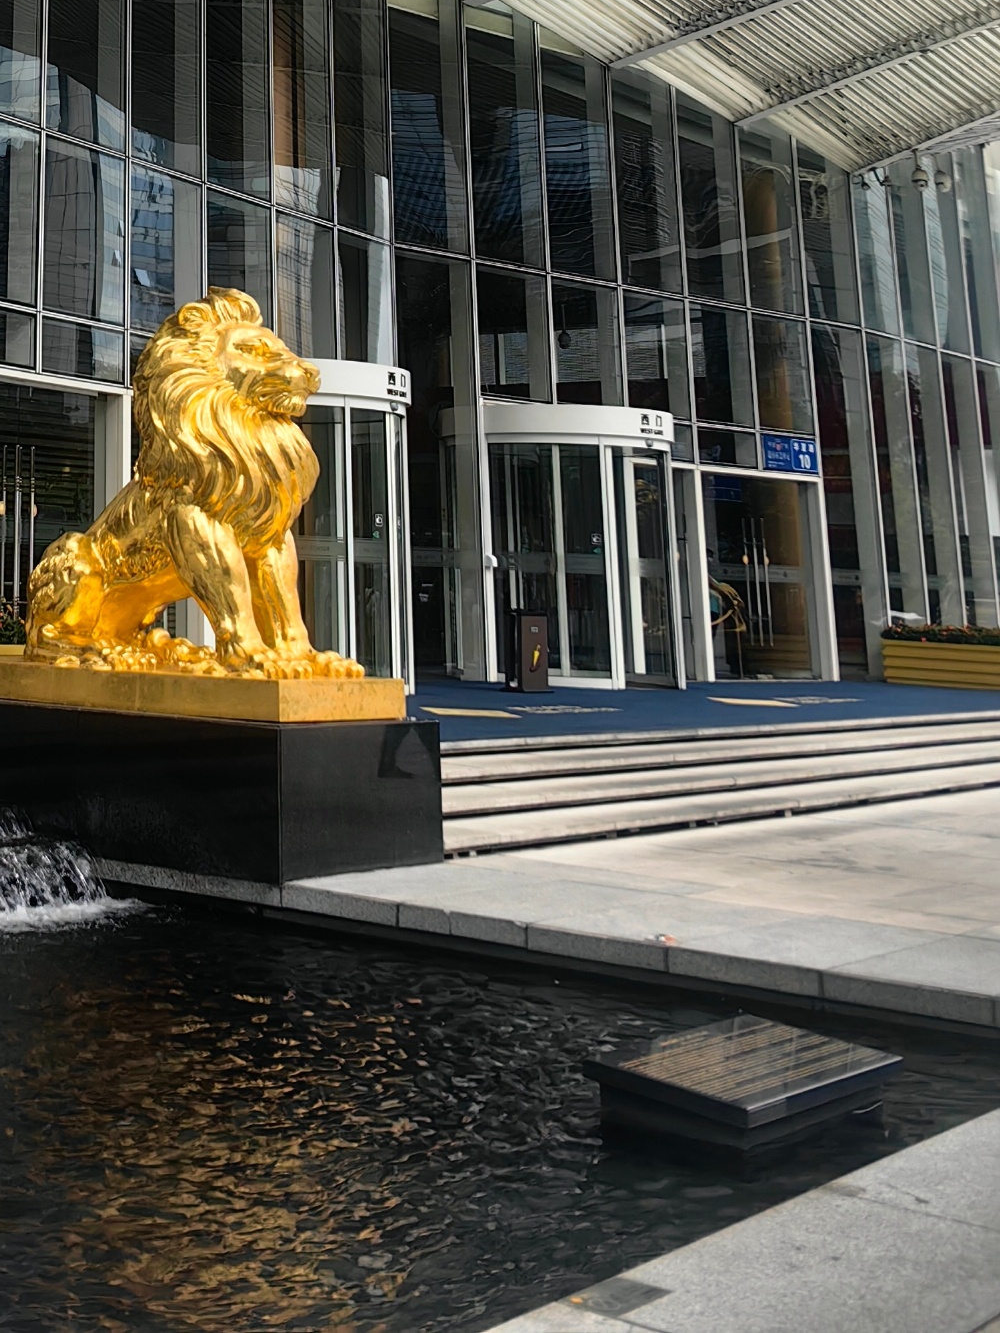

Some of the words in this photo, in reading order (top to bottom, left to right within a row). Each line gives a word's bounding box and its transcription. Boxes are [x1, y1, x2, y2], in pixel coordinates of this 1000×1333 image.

[387, 371, 406, 388] 西门
[387, 388, 398, 396] WEST
[640, 413, 662, 427] 西门
[798, 454, 811, 469] 10
